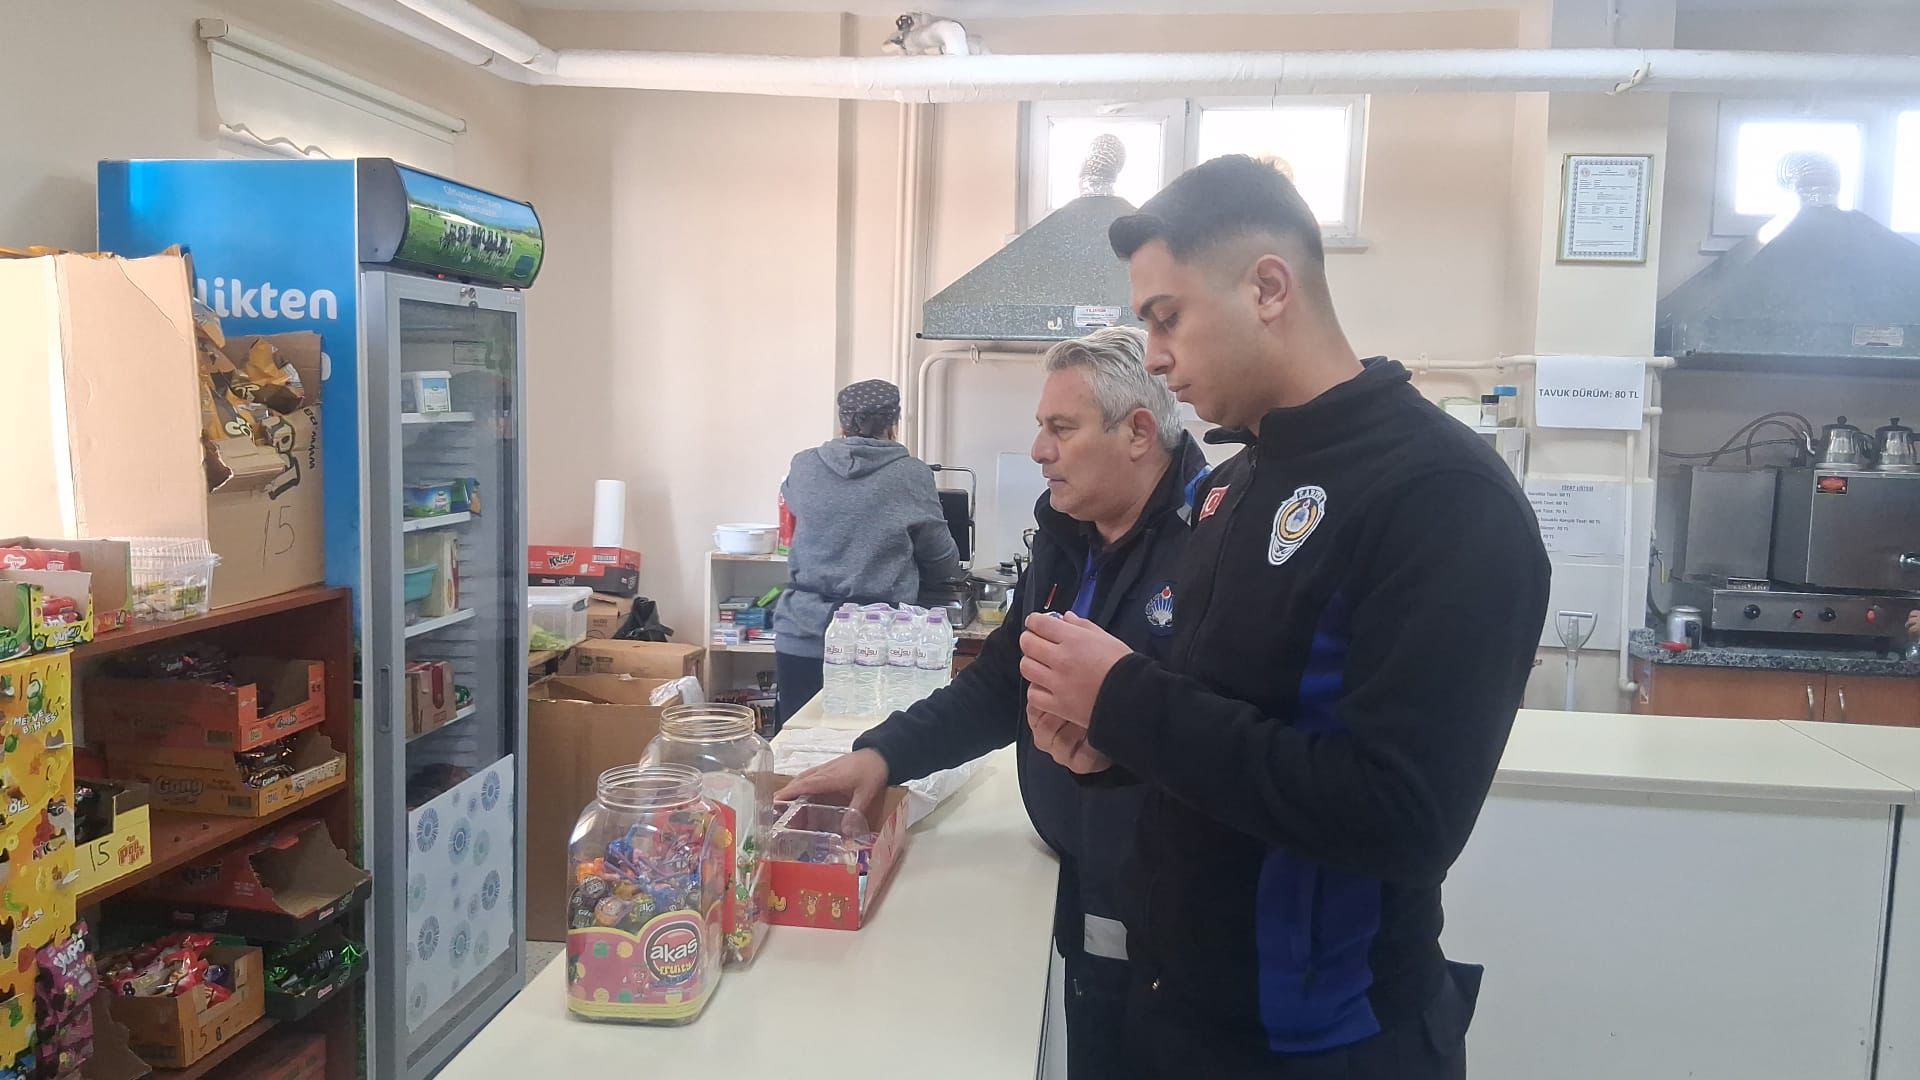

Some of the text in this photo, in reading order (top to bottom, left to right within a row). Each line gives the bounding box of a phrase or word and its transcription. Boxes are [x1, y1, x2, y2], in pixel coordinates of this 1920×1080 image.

[1538, 387, 1640, 399] TAVUK DÜRÜM: 80 TL
[262, 505, 295, 569] 15
[20, 671, 42, 701] 15
[89, 840, 110, 871] 15
[650, 938, 698, 963] akas
